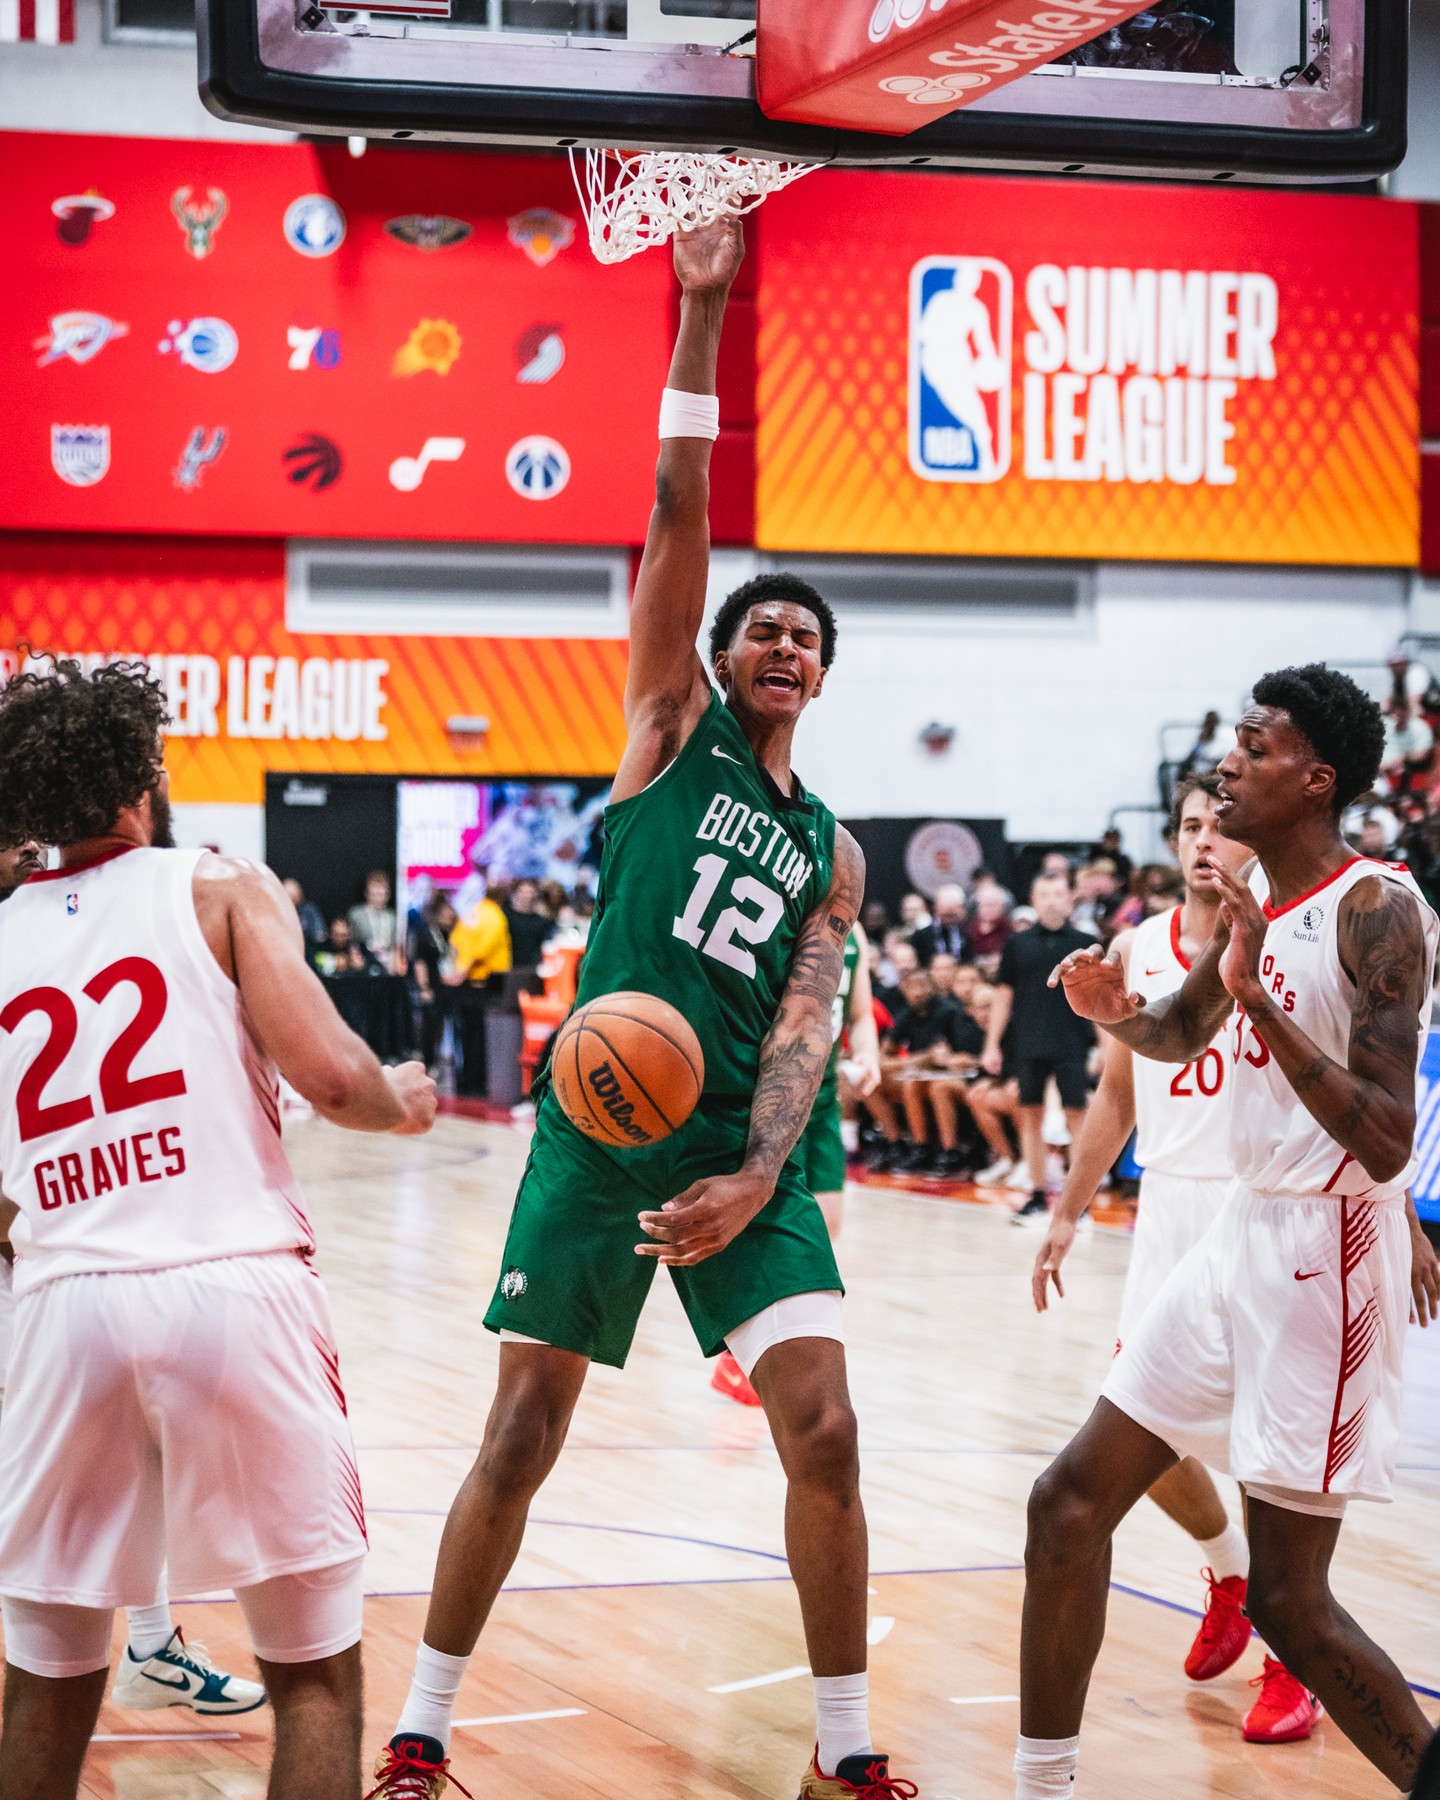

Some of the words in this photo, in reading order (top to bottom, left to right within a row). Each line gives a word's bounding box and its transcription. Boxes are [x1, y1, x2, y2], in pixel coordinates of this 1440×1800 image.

[286, 325, 342, 371] 76
[1024, 263, 1279, 380] SUMMER
[1022, 371, 1239, 485] LEAGUE
[226, 655, 390, 741] LEAGUE
[695, 792, 814, 900] BOSTON
[671, 852, 786, 981] 12
[1291, 930, 1307, 942] Sun
[0, 955, 188, 1144] 22
[1169, 1047, 1225, 1098] 20
[588, 1060, 654, 1143] Wilson
[33, 1126, 187, 1212] GRAVES
